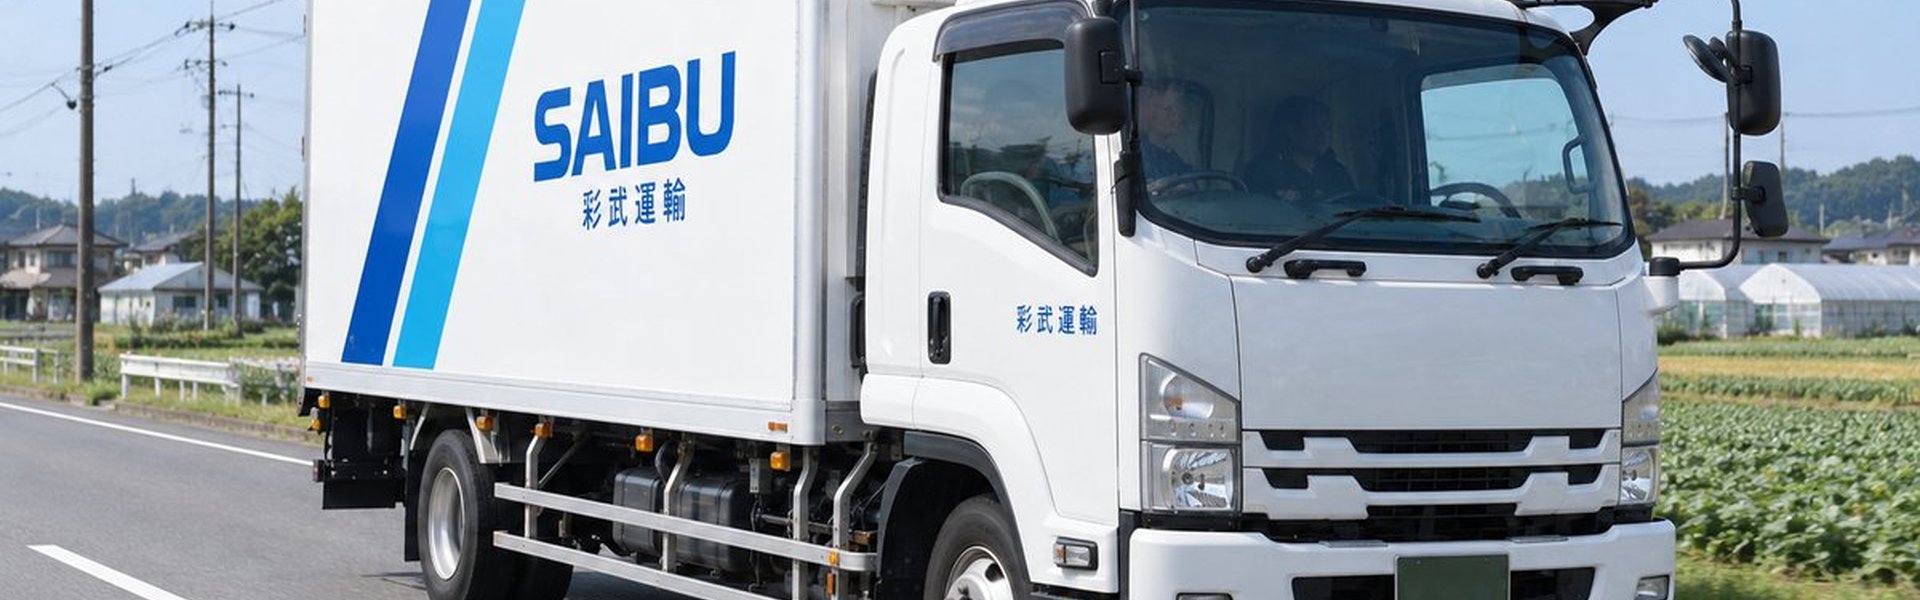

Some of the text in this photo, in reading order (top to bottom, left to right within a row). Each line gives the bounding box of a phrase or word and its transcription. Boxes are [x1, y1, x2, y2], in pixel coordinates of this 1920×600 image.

[534, 51, 736, 182] SAIBU
[582, 177, 686, 230] 彩武運輸
[1016, 304, 1098, 335] 彩武運輸
